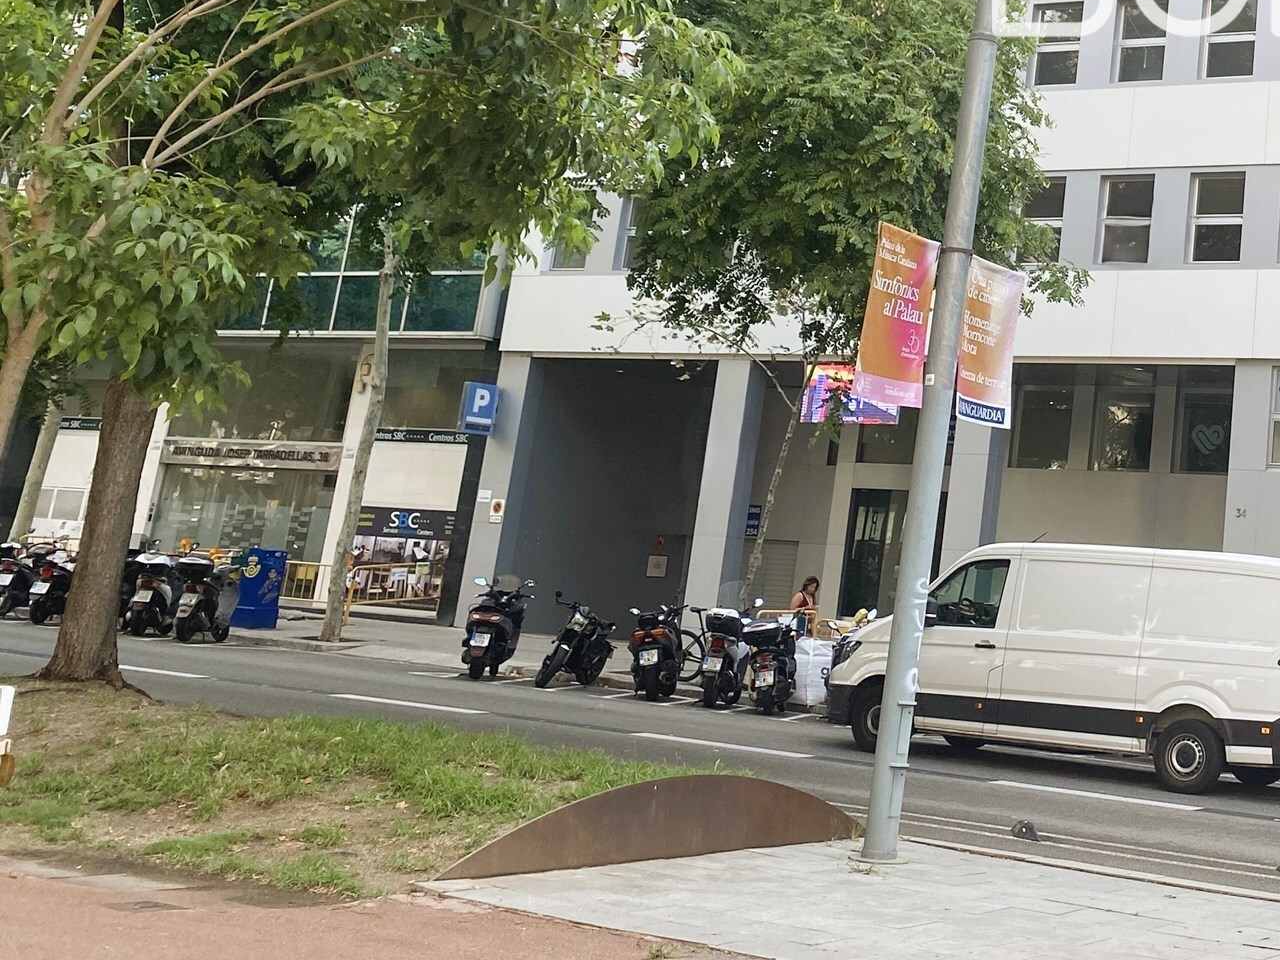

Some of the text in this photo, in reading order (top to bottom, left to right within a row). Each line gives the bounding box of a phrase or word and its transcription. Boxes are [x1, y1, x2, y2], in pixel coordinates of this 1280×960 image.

[967, 284, 979, 300] de
[883, 298, 923, 325] al Palau
[472, 387, 491, 413] P
[428, 432, 455, 442] Centros
[455, 433, 469, 443] SBC
[171, 446, 221, 458] AVINGUDA
[389, 511, 421, 528] SBC
[1235, 507, 1246, 518] 34
